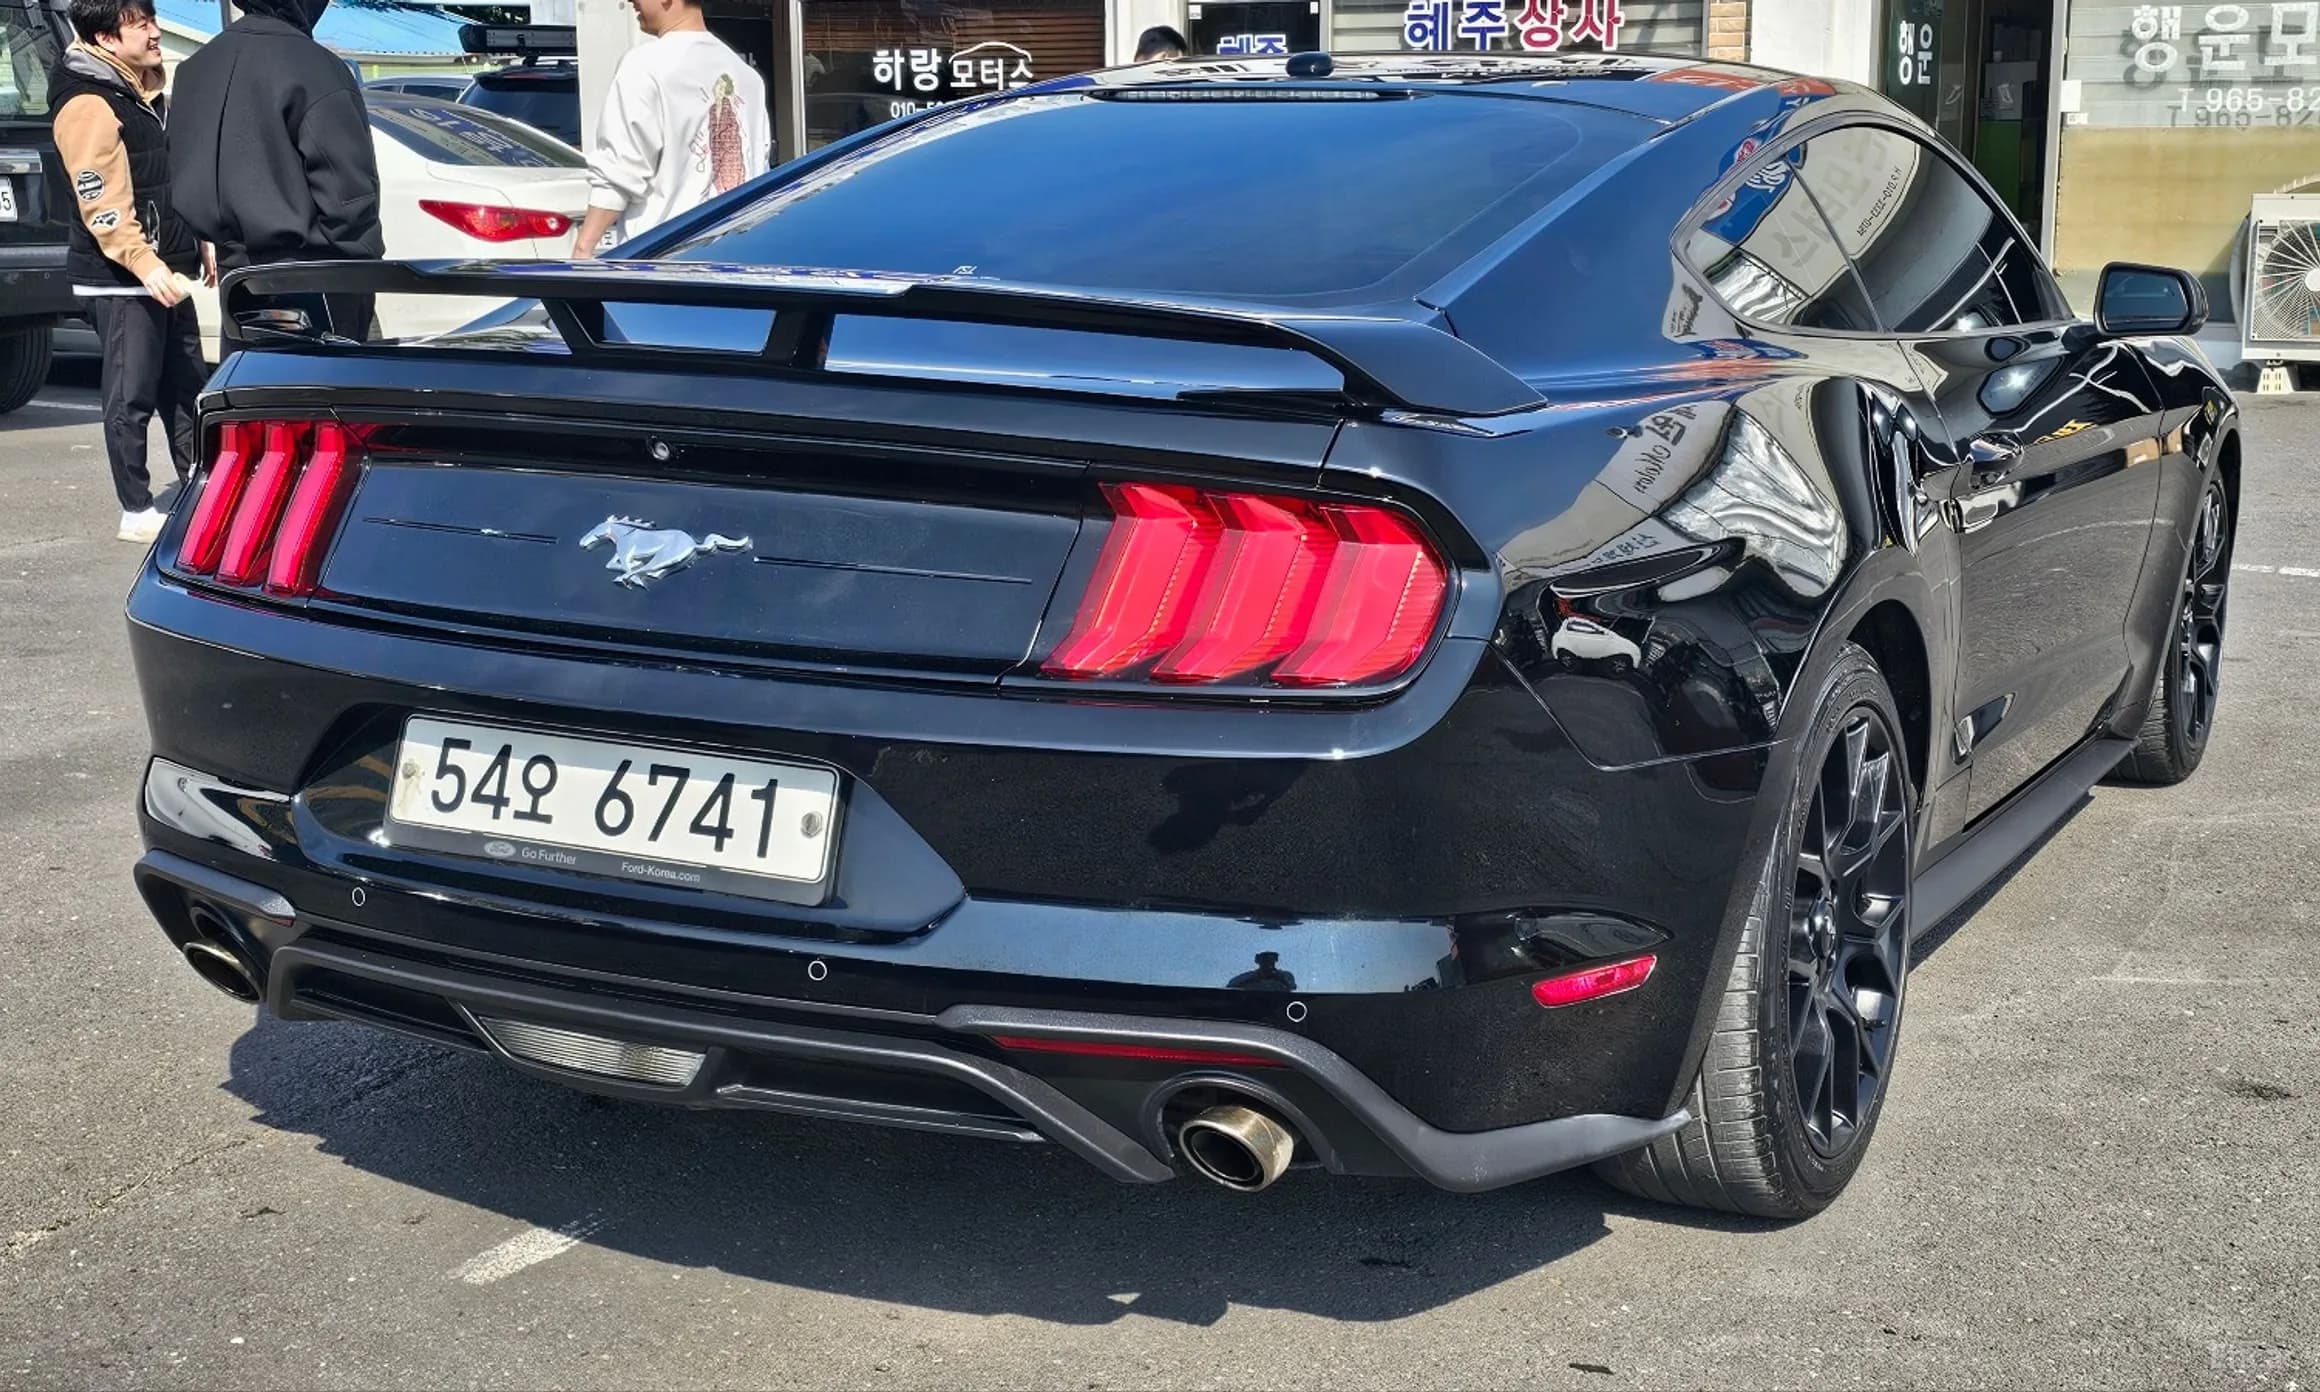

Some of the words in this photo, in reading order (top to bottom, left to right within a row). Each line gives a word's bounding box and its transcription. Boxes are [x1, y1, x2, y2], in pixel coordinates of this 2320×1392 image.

[872, 48, 942, 91] 하랑
[950, 58, 1034, 91] 모터스
[1899, 20, 1933, 85] 행운
[431, 737, 559, 824] 54오
[595, 759, 779, 859] 6741
[521, 847, 537, 859] Go
[539, 849, 577, 865] Further
[621, 861, 701, 883] Ford-Korea.com
